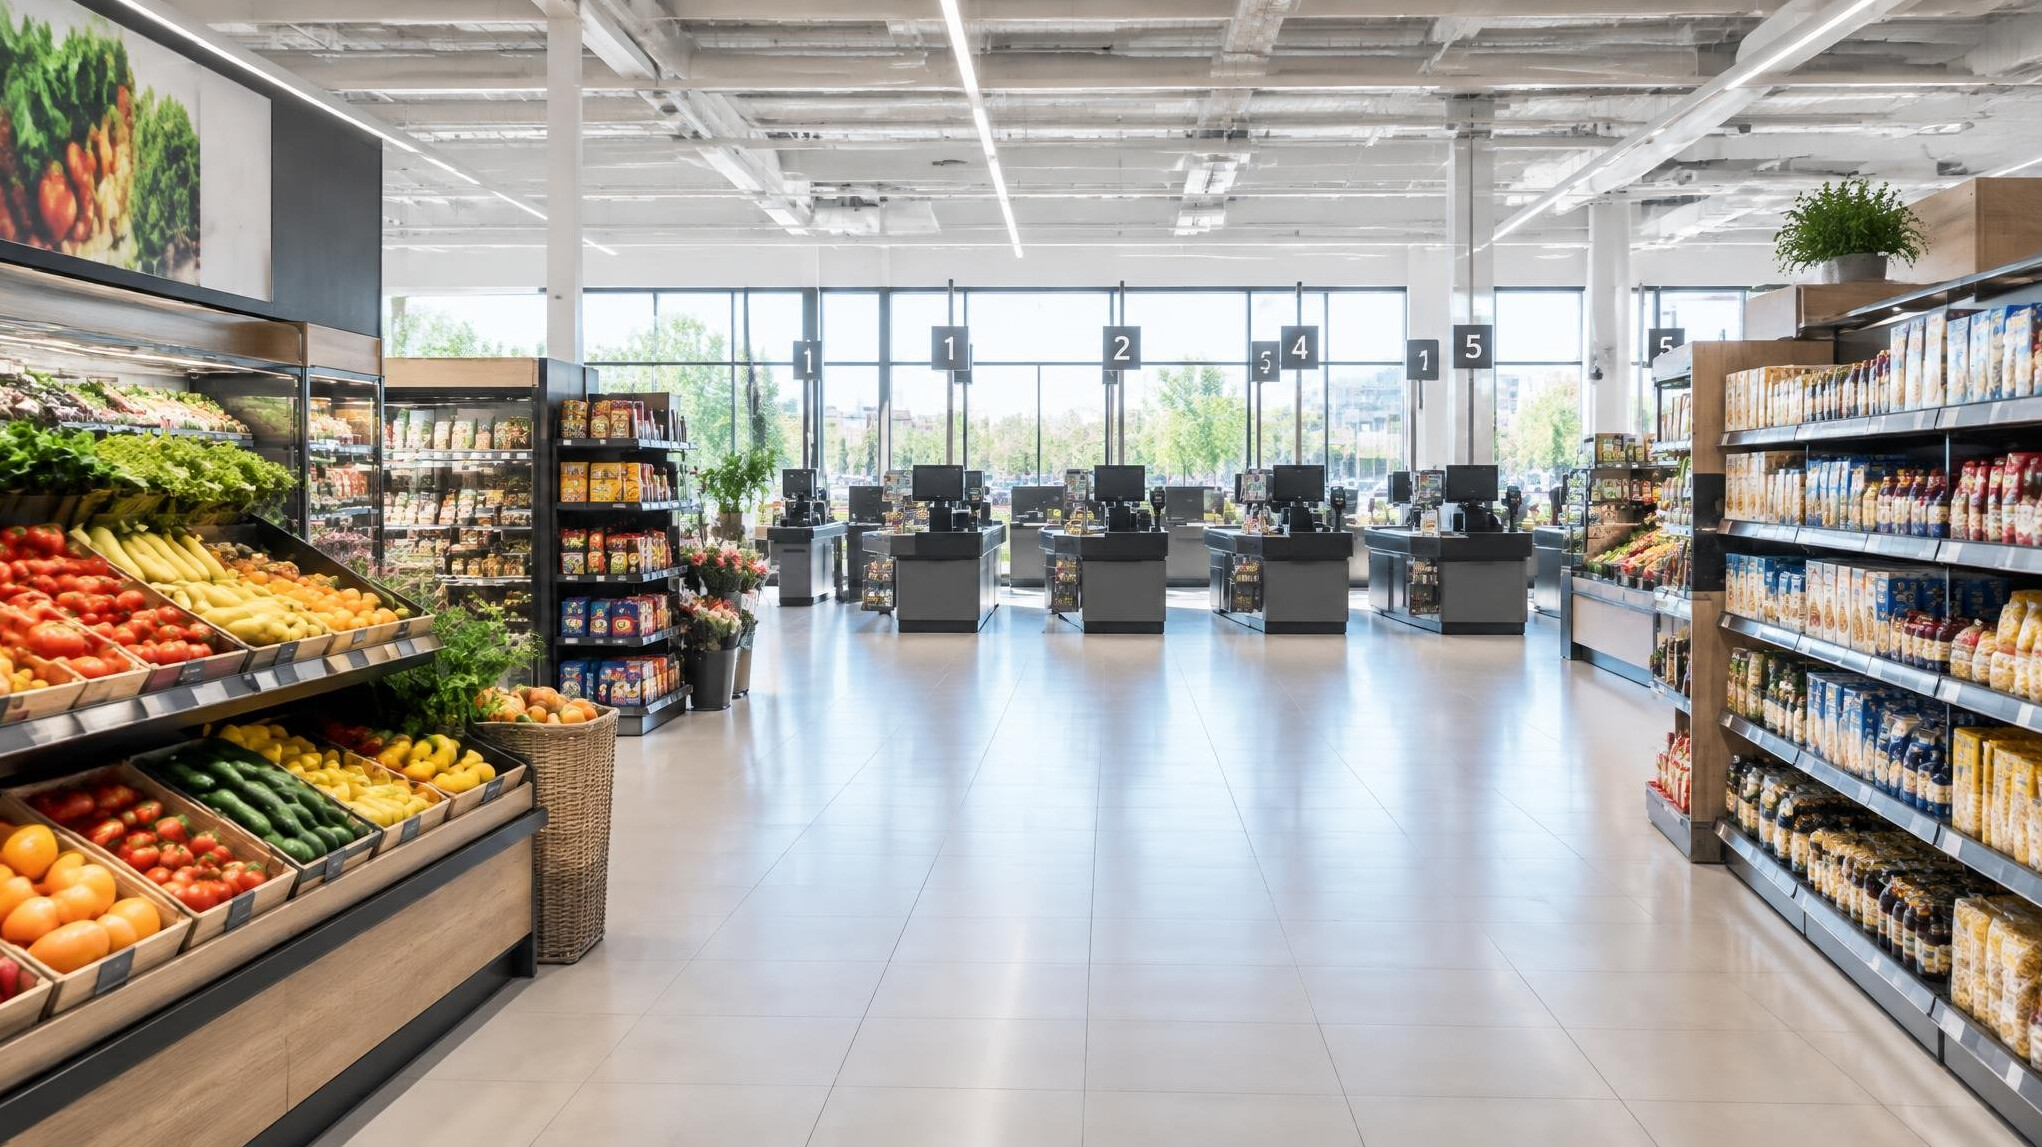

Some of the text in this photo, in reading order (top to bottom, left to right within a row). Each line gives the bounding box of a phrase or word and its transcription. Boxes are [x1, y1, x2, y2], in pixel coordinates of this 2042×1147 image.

[944, 336, 954, 361] 1
[1113, 335, 1131, 361] 2
[1291, 335, 1309, 360] 4
[1465, 334, 1482, 359] 5
[804, 347, 813, 374] 1
